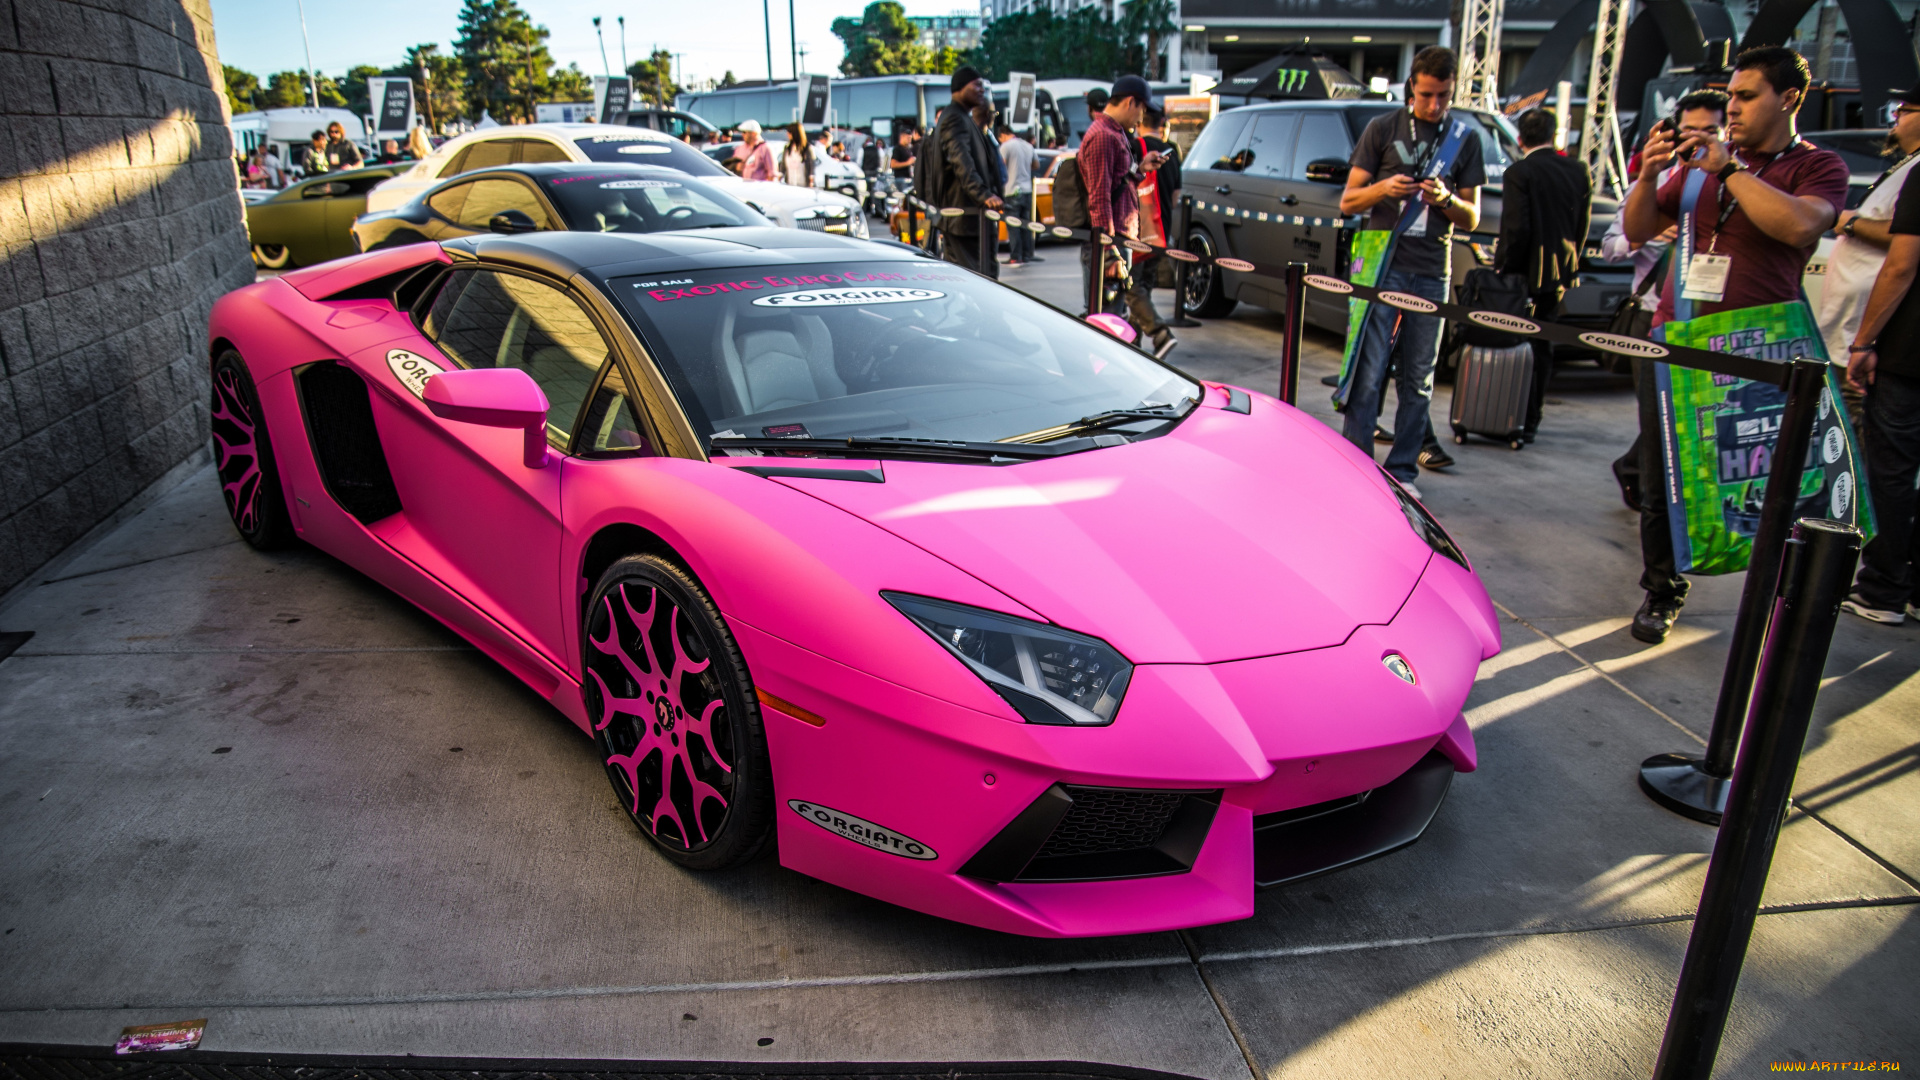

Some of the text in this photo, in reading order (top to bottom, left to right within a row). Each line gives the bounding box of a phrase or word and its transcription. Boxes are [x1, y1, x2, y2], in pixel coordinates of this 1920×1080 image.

[389, 90, 408, 99] LOAD
[611, 86, 628, 95] LOAD
[388, 100, 406, 108] HERE
[610, 96, 626, 104] HERE
[389, 109, 404, 117] FOR
[610, 105, 623, 113] FOR
[1586, 247, 1604, 258] DU
[647, 280, 764, 302] EXOTIC
[763, 274, 843, 287] EURO
[661, 278, 695, 286] SALE
[1307, 276, 1350, 291] FORGIATO
[768, 290, 932, 305] FORGIATO
[1382, 293, 1434, 310] FORGIATO
[1474, 313, 1536, 331] FORGIATO
[1586, 335, 1663, 355] FORGIATO
[1709, 335, 1726, 351] IF
[798, 803, 925, 855] FORGIATO
[837, 828, 881, 848] WHEELS
